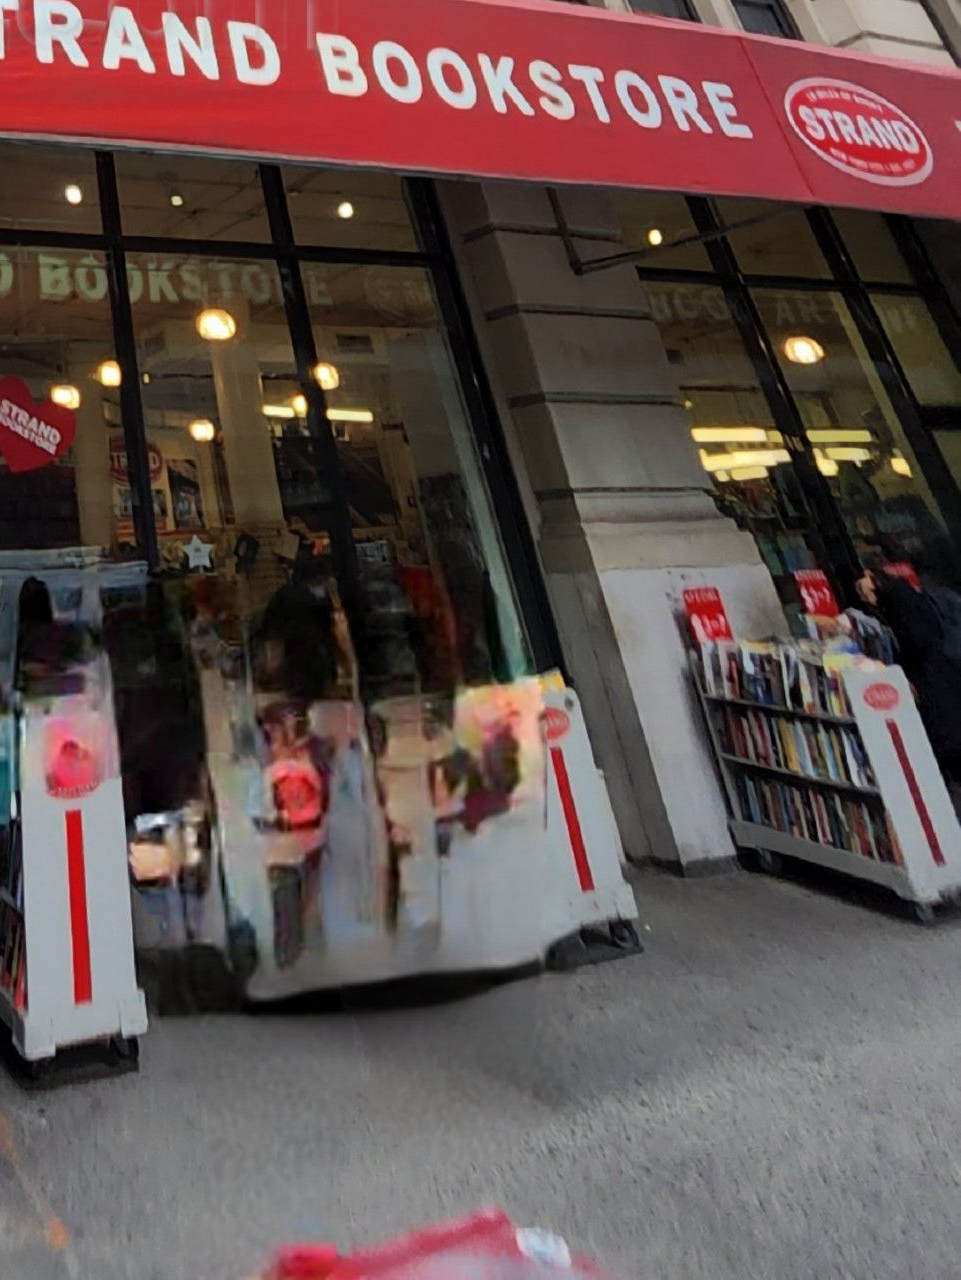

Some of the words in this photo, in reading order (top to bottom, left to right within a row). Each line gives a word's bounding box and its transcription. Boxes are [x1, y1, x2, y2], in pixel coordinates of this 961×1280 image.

[316, 32, 753, 139] BOOKSTORE
[798, 105, 920, 154] STRAND
[38, 253, 332, 305] BOOKSTOE
[0, 400, 61, 445] STRAND
